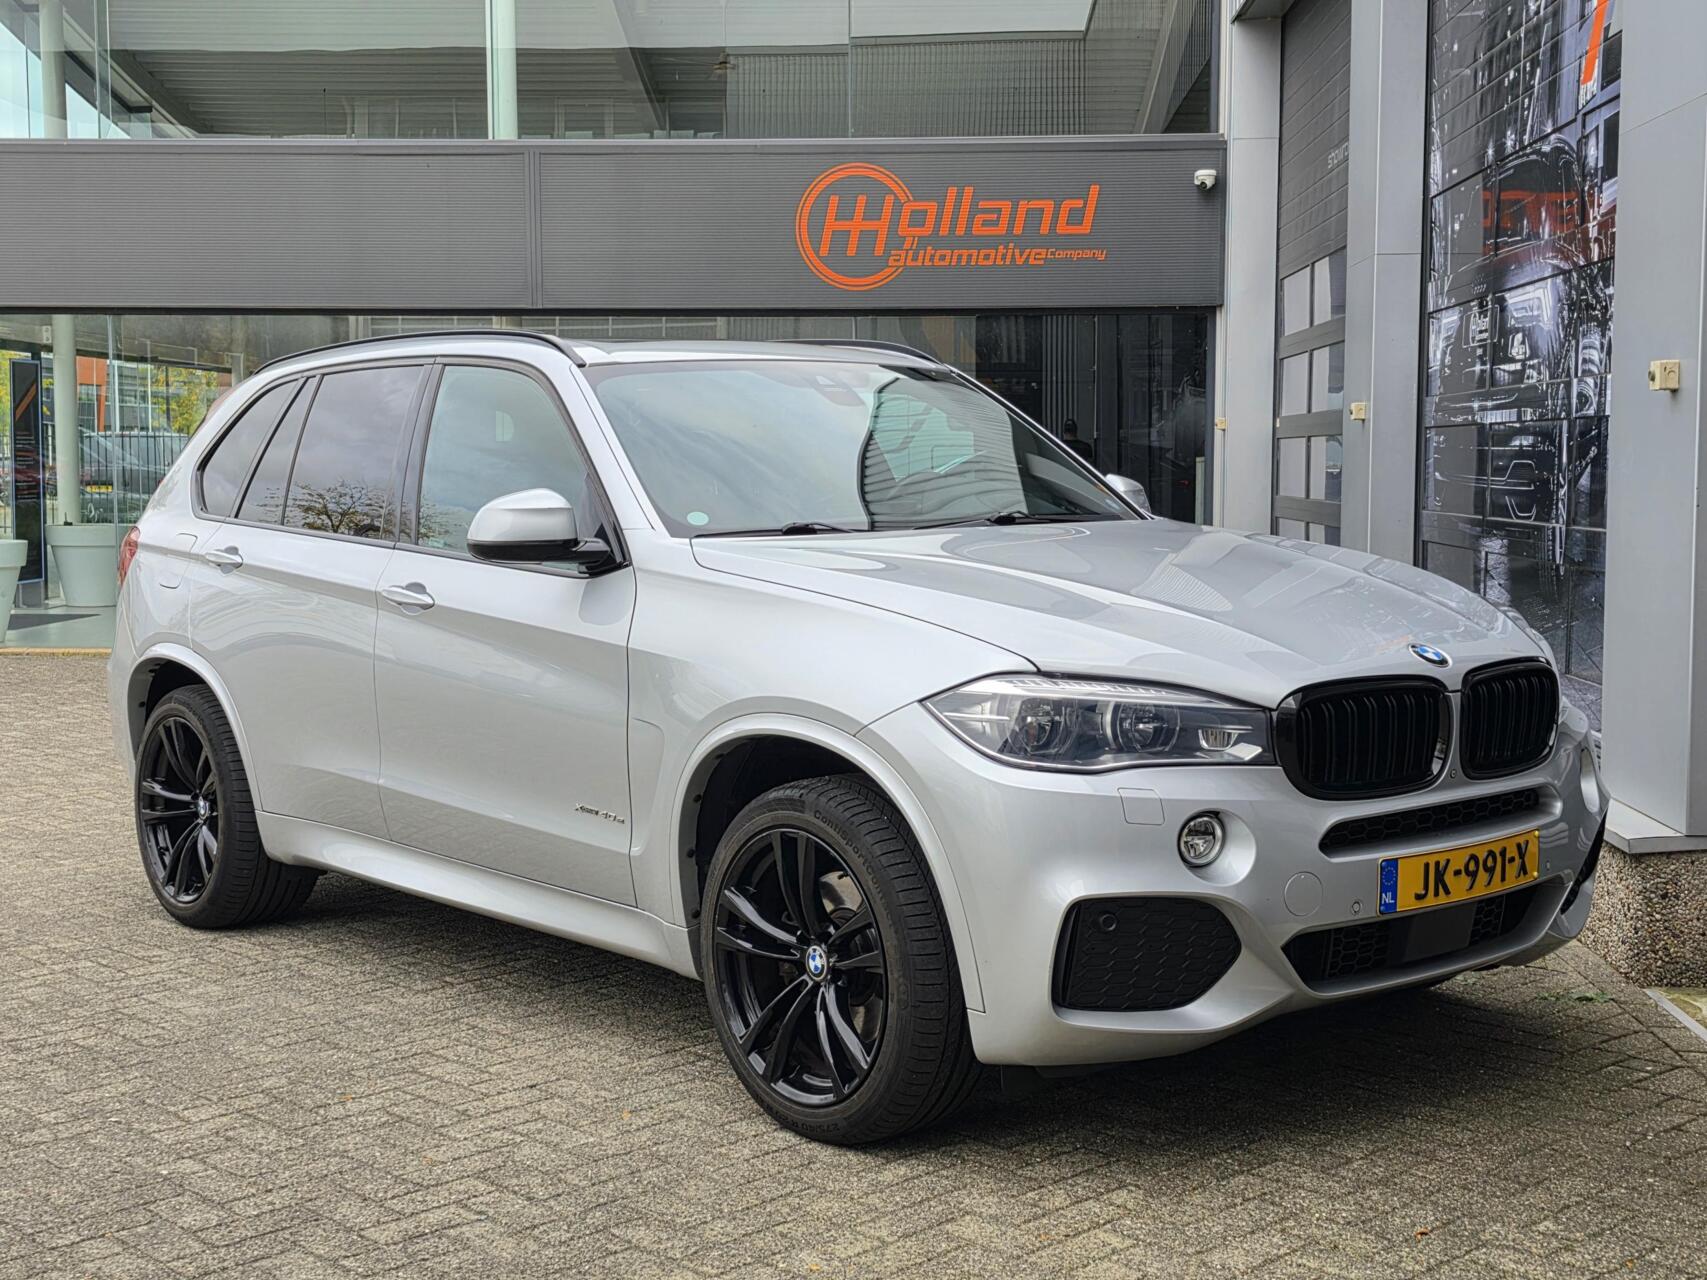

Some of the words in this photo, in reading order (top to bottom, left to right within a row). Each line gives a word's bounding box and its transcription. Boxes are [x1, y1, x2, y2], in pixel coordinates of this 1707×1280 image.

[887, 242, 1047, 267] automotive
[1047, 247, 1107, 261] Company
[1414, 840, 1529, 901] JK-991-X
[1381, 891, 1395, 905] NL
